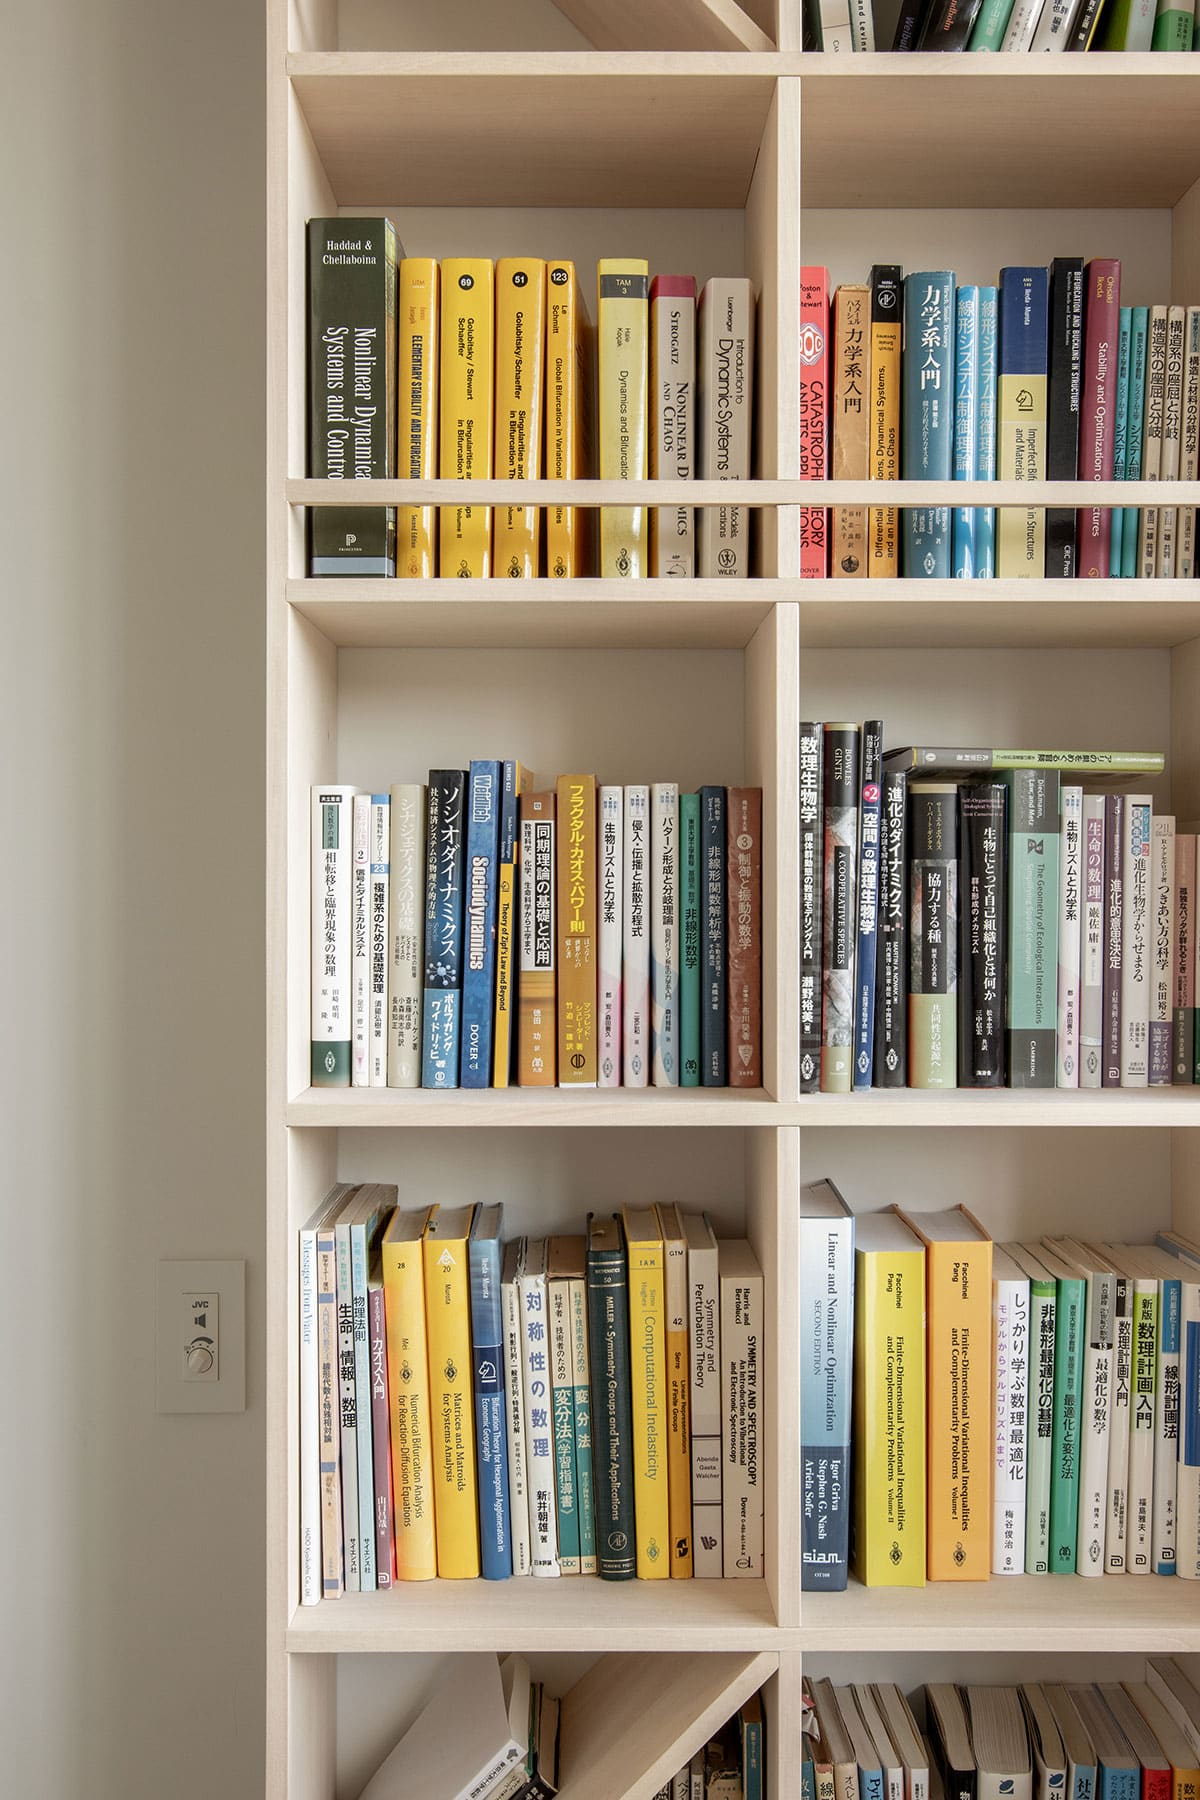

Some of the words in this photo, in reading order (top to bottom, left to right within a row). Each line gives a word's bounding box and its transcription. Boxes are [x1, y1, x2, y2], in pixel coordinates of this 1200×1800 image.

[322, 254, 377, 266] Chellaboina
[326, 240, 363, 251] Haddad
[459, 278, 473, 287] 69
[552, 272, 567, 282] 123
[615, 279, 632, 287] TAM
[457, 317, 466, 357] Schaeffer
[465, 317, 474, 361] Golubitsky
[551, 304, 561, 334] Schmitt
[920, 284, 941, 390] 力学系入門
[322, 326, 350, 389] Systems
[354, 327, 377, 401] Nonlinear
[411, 335, 423, 380] ELEMENTARY
[554, 357, 564, 384] Global
[715, 339, 733, 409] Dynamic
[734, 339, 745, 390] Introduction
[843, 327, 864, 414] 力学系入門
[1095, 342, 1109, 382] Stability
[1148, 318, 1166, 439] 構造系の座屈と分岐
[1165, 320, 1183, 440] 構造系の座屈と分岐
[326, 395, 350, 423] and
[410, 381, 422, 417] STABILITY
[466, 368, 474, 401] Stewart
[554, 385, 564, 427] Bifurcation
[618, 370, 630, 415] Dynamics
[874, 365, 885, 408] Systems,
[956, 301, 975, 471] 線形システム制御理論
[464, 419, 474, 470] Singularities
[508, 420, 517, 463] Bifurcation
[516, 410, 527, 462] Singularities
[663, 406, 676, 453] CHAOS
[676, 382, 689, 461] NONLINEAR
[715, 410, 733, 471] Systems
[874, 409, 885, 457] Dynamical
[886, 427, 895, 458] Chaos
[1025, 428, 1038, 463] Imperfect
[1093, 406, 1106, 473] Optimization
[456, 428, 465, 475] Bifurcation
[554, 438, 564, 479] Variational
[1025, 521, 1037, 561] Structures
[1062, 561, 1071, 578] Press
[800, 736, 819, 823] 数理生物学
[834, 748, 843, 781] GINTIS
[472, 774, 492, 823] Weidlich
[373, 864, 385, 873] 23
[439, 787, 461, 957] ソシオダイナミクス
[569, 785, 586, 934] フラクタル・カオス・パワー則
[603, 822, 616, 923] 生物リズムと力学系
[662, 816, 674, 926] パターン形成と分岐理論
[860, 806, 879, 935] 「空間」の数理生物学
[887, 786, 904, 918] 進化のダイナミクス
[1065, 819, 1079, 921] 生物リズムと力学系
[1087, 822, 1102, 899] 生命の数理
[536, 824, 551, 966] 同期理論の基礎と応用
[631, 819, 643, 937] 侵入・伝播と拡散方程式
[707, 846, 722, 942] 非線形関数解析学
[738, 853, 752, 950] 制御と振動の数学
[837, 860, 846, 926] COOPERATIVE
[324, 851, 338, 977] 相転移と臨界現象の数理
[355, 868, 366, 958] 信号とダイナミカルシステム
[468, 856, 490, 970] Sociodynamics
[927, 872, 942, 944] 協力する種
[983, 827, 997, 1001] 生物にとって自己組織化とは何か
[1132, 858, 1147, 983] 進化生物学からせまる
[1156, 885, 1170, 971] つきあい方の科学
[373, 882, 386, 994] 複雑系のための基礎数理
[685, 908, 697, 969] 非線形数学
[836, 927, 845, 965] SPECIES
[1035, 975, 1044, 1025] Interactions
[1157, 982, 1168, 1021] 松田裕之
[469, 1024, 479, 1060] DOVER
[302, 1239, 313, 1286] Messages
[442, 1265, 452, 1273] 20
[668, 1249, 684, 1257] GTM
[827, 1232, 839, 1271] Linear
[952, 1262, 960, 1283] Pang
[743, 1288, 751, 1311] Harris
[886, 1273, 894, 1293] Pang
[895, 1273, 903, 1309] Facchinei
[961, 1262, 969, 1300] Facchinei
[353, 1295, 366, 1342] 物理法則
[573, 1291, 585, 1373] 科学者・技術者のための
[672, 1317, 683, 1326] 42
[695, 1283, 705, 1349] Perturbation
[704, 1299, 715, 1351] Symmetry
[814, 1299, 822, 1337] SECOND
[826, 1298, 838, 1354] Nonlinear
[1141, 1298, 1153, 1321] 新版
[554, 1293, 566, 1381] 科学者・技術者のための
[606, 1330, 617, 1379] Symmetry
[747, 1335, 757, 1388] SYMMETRY
[814, 1338, 822, 1376] EDITION
[338, 1303, 357, 1428] 生命・情報・数理
[372, 1337, 385, 1400] カオス入門
[526, 1291, 550, 1457] 対称性の数理
[642, 1316, 658, 1409] Computational
[695, 1351, 706, 1389] Theory
[896, 1336, 904, 1424] Finite-Dimensional
[961, 1327, 970, 1419] Finite-Dimensional
[996, 1304, 1008, 1468] モデルからアルゴリズムまで
[1009, 1292, 1027, 1481] しっかり学ぶ数理最適化
[1037, 1303, 1055, 1438] 非線形最適化の基礎
[1116, 1320, 1131, 1408] 数理計画入門
[1135, 1322, 1155, 1430] 数理計画入門
[410, 1394, 421, 1436] Numerical
[453, 1392, 463, 1431] Matrices
[607, 1380, 618, 1415] Groups
[730, 1376, 738, 1412] Electronic
[739, 1371, 747, 1417] Introduction
[824, 1357, 838, 1432] Optimization
[885, 1355, 895, 1437] Complementarity
[950, 1348, 960, 1433] Complementarity
[1093, 1358, 1108, 1435] 最適化の数学
[1163, 1365, 1179, 1440] 線形計画法
[442, 1407, 454, 1444] Systems
[575, 1390, 592, 1449] 変分法
[671, 1407, 679, 1433] Groups
[680, 1401, 688, 1454] Representations
[729, 1413, 738, 1463] Spectroscopy
[1061, 1394, 1076, 1480] 最適化と変分法
[412, 1437, 424, 1483] Bifurcation
[443, 1444, 456, 1483] Analysis
[644, 1413, 660, 1481] Inelasticity
[739, 1426, 747, 1466] Vibrational
[747, 1411, 757, 1487] SPECTROSCOPY
[830, 1459, 841, 1481] Igor
[887, 1439, 895, 1482] Problems
[896, 1426, 905, 1476] Variational
[952, 1435, 960, 1480] Problems
[961, 1422, 970, 1473] Variational
[456, 1451, 466, 1492] Matroids
[609, 1462, 621, 1521] Applications
[816, 1459, 828, 1499] Stephen
[402, 1486, 412, 1528] Equations
[412, 1484, 425, 1519] Analysis
[536, 1490, 549, 1533] 新井朝雄
[739, 1496, 748, 1518] Dover
[804, 1490, 815, 1518] Sofer
[831, 1482, 841, 1511] Griva
[895, 1478, 905, 1532] Inequalities
[960, 1475, 970, 1532] Inequalities
[818, 1514, 828, 1540] Nash
[1004, 1509, 1014, 1549] 梅谷俊治
[349, 1537, 358, 1574] サイエンス社
